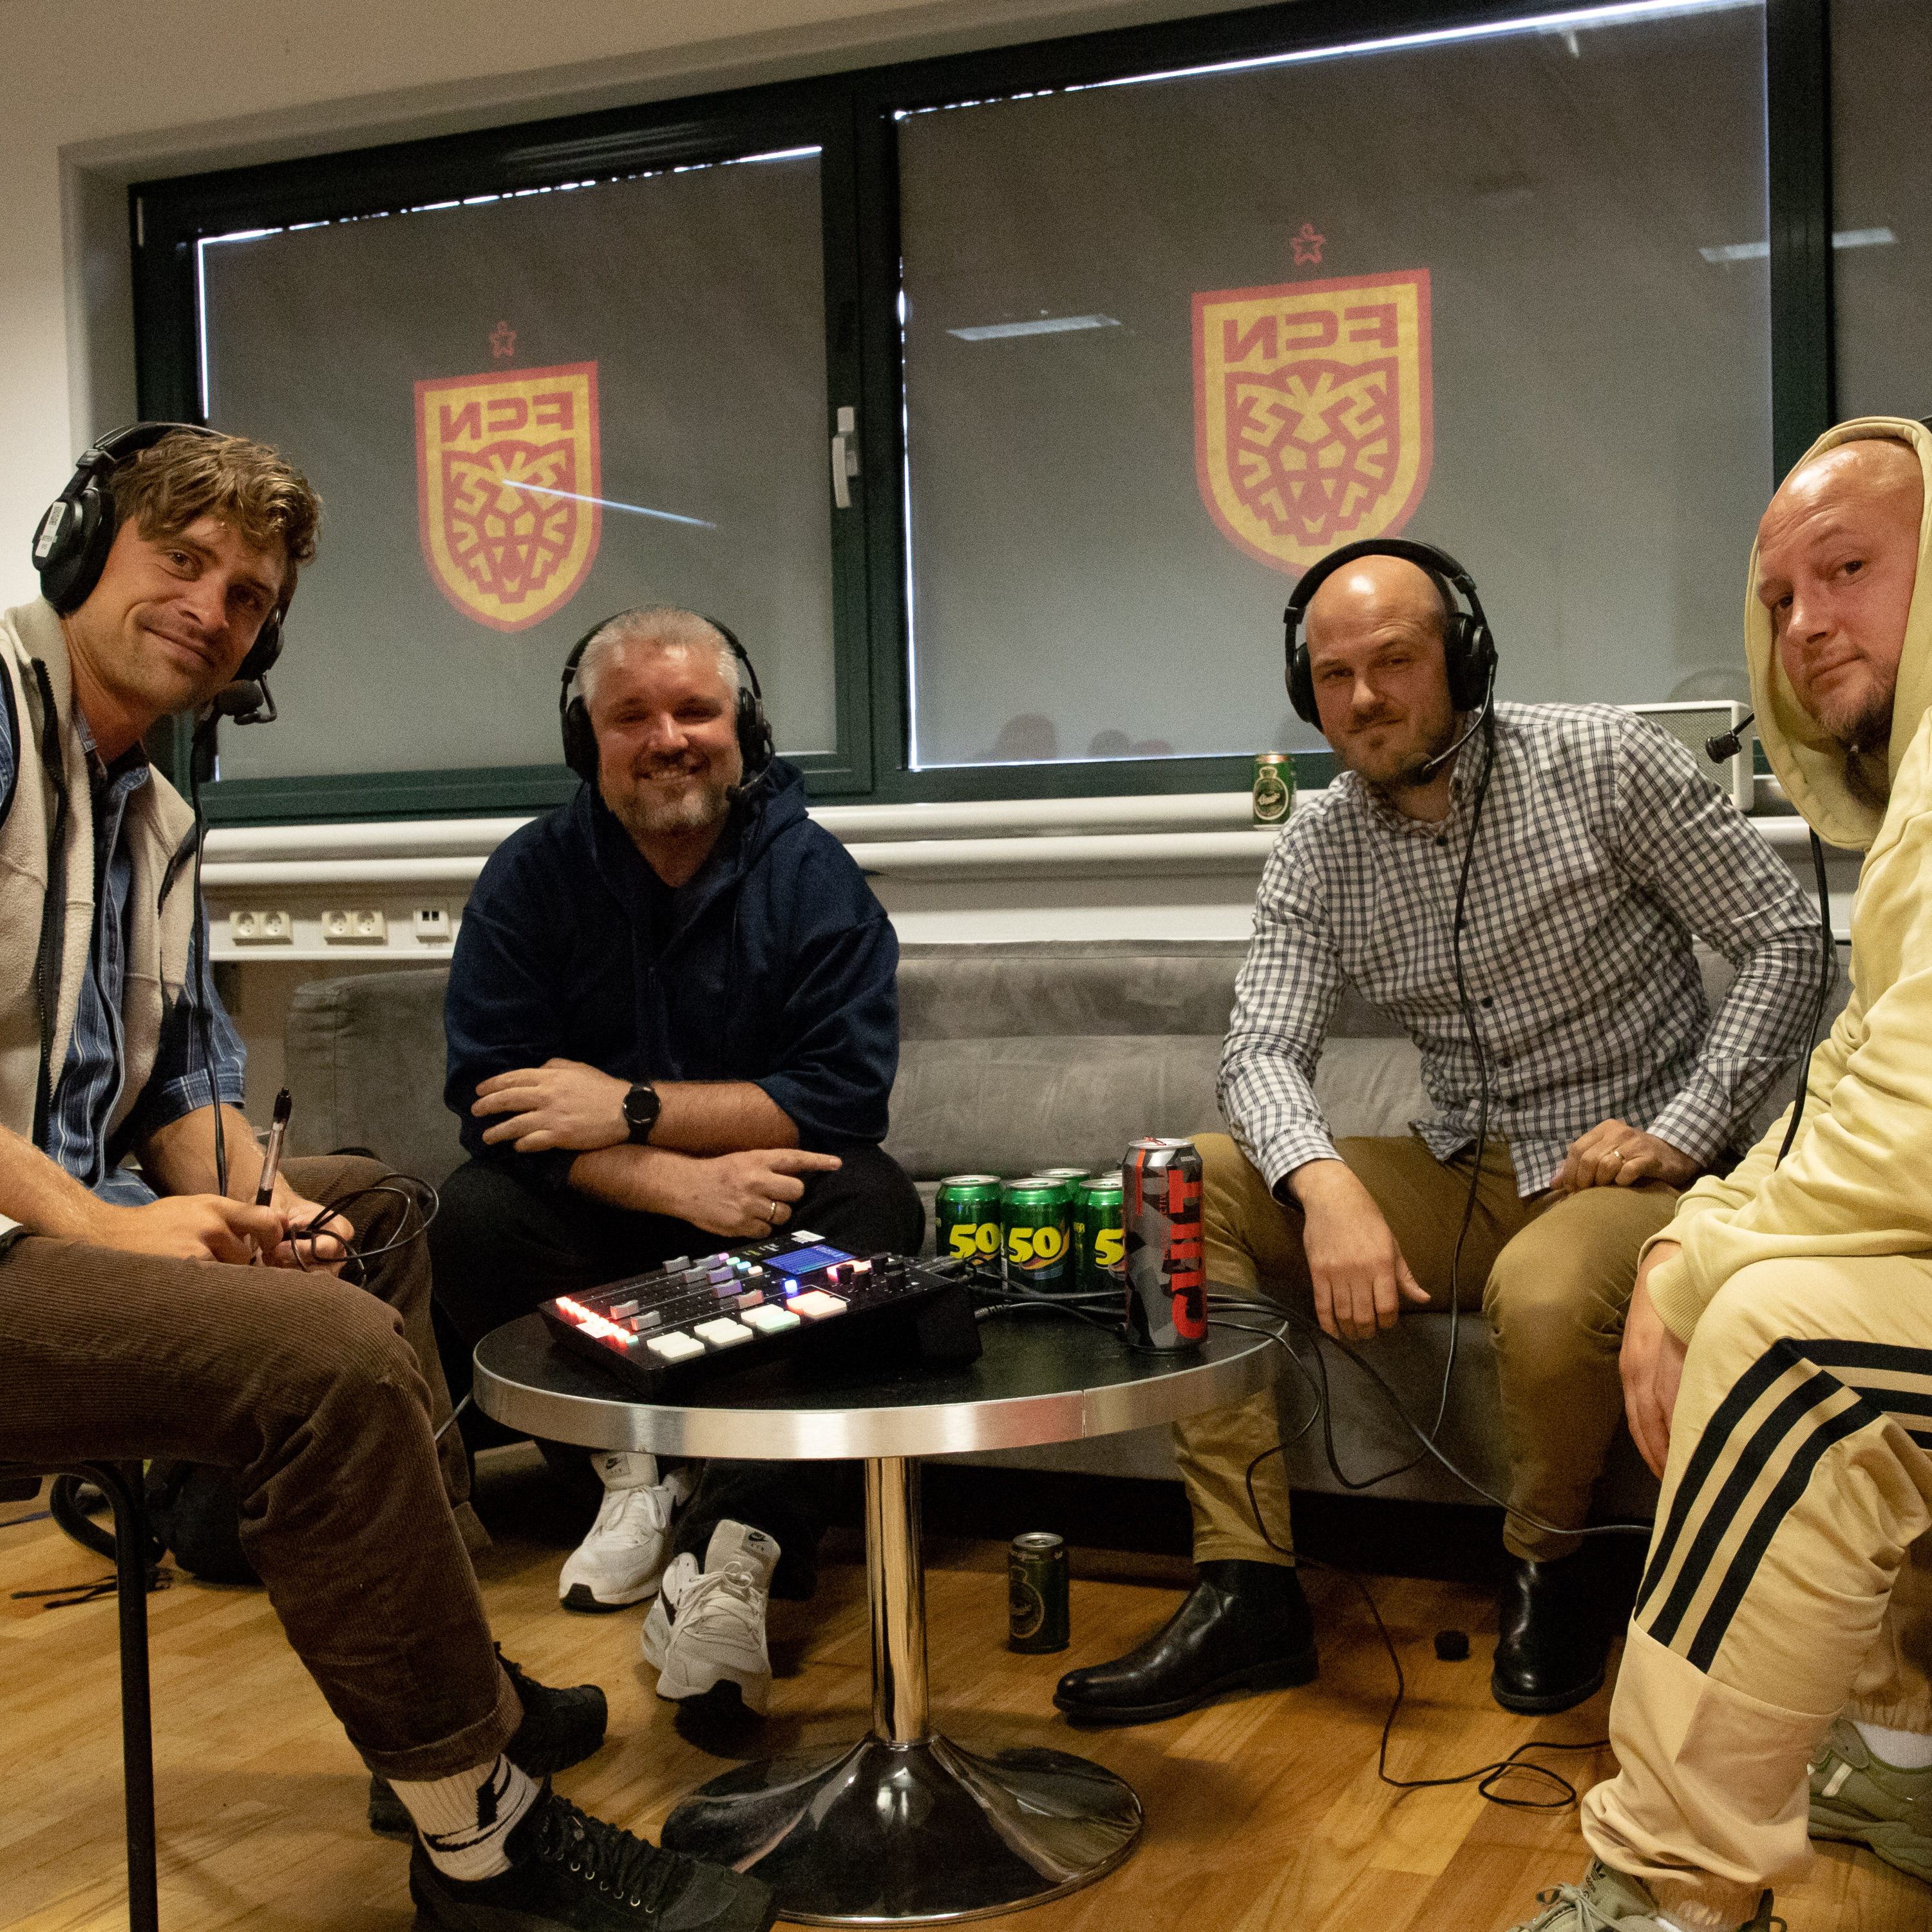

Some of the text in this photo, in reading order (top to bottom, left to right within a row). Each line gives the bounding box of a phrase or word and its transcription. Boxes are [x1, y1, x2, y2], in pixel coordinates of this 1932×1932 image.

[949, 1223, 1001, 1259] 50
[1009, 1226, 1062, 1262] 50
[1095, 1229, 1124, 1265] 5
